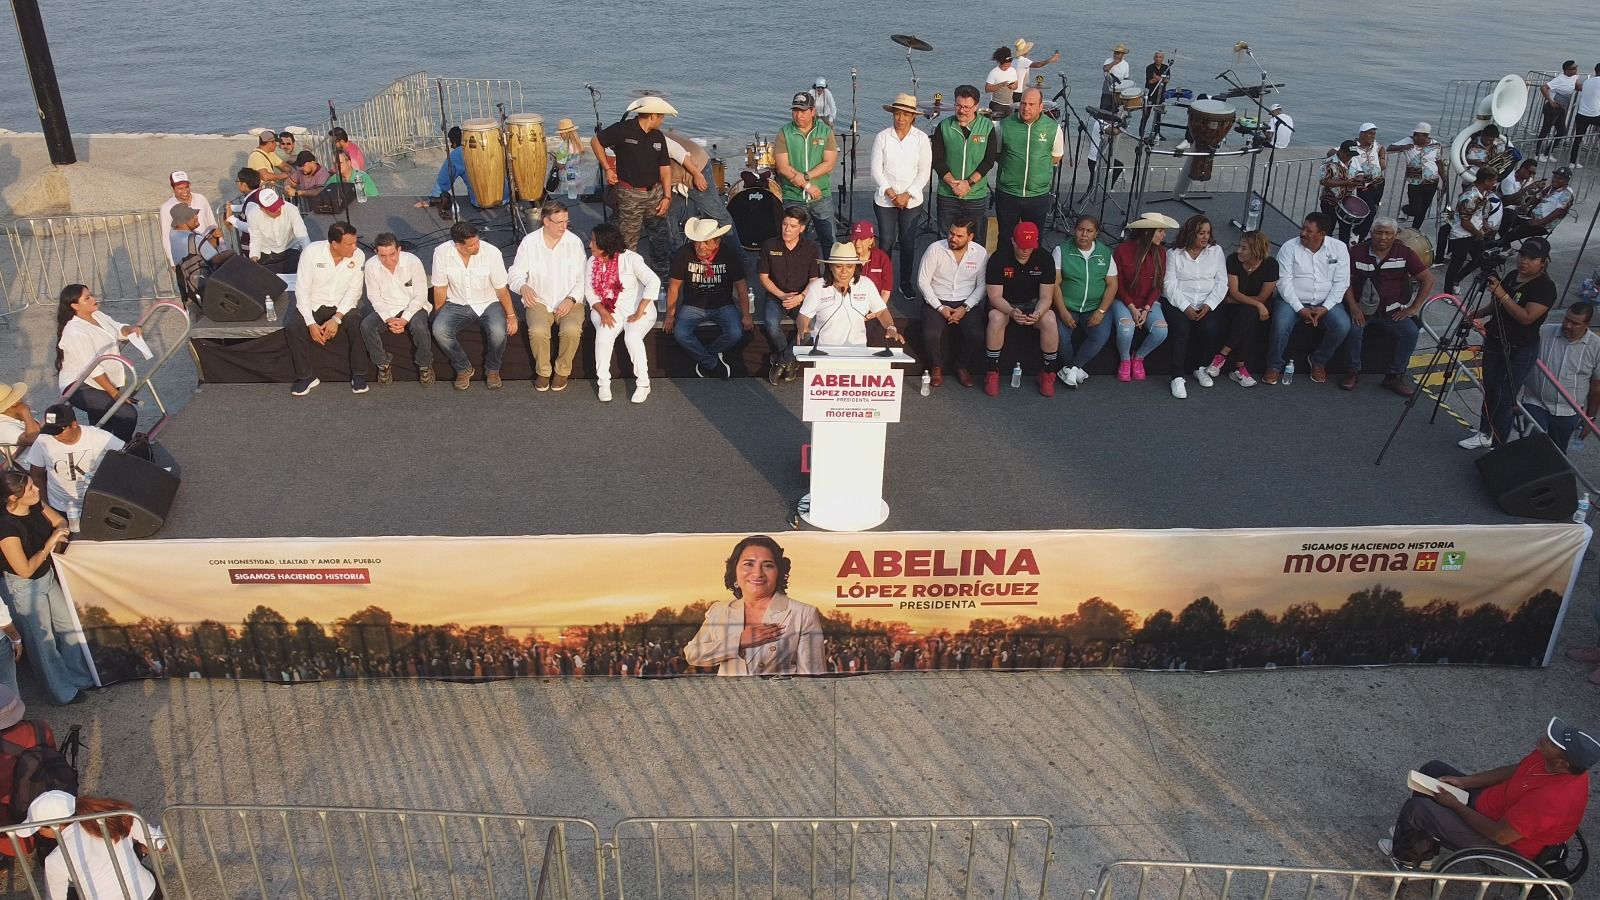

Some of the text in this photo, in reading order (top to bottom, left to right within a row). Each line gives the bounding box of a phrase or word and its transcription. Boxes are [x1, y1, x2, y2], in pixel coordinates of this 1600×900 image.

[711, 264, 727, 273] TATE
[810, 374, 896, 388] ABELINA
[810, 388, 896, 397] LÓPEZ RODRÍGUEZ
[825, 410, 864, 418] morena
[1302, 541, 1455, 551] SIGAMOS HACIENDO HISTORIA
[836, 548, 1041, 578] ABELINA
[1283, 551, 1409, 573] morena
[1415, 559, 1436, 570] PT
[836, 580, 1040, 599] LÓPEZ RODRÍGUEZ
[900, 600, 977, 610] PRESIDENTA
